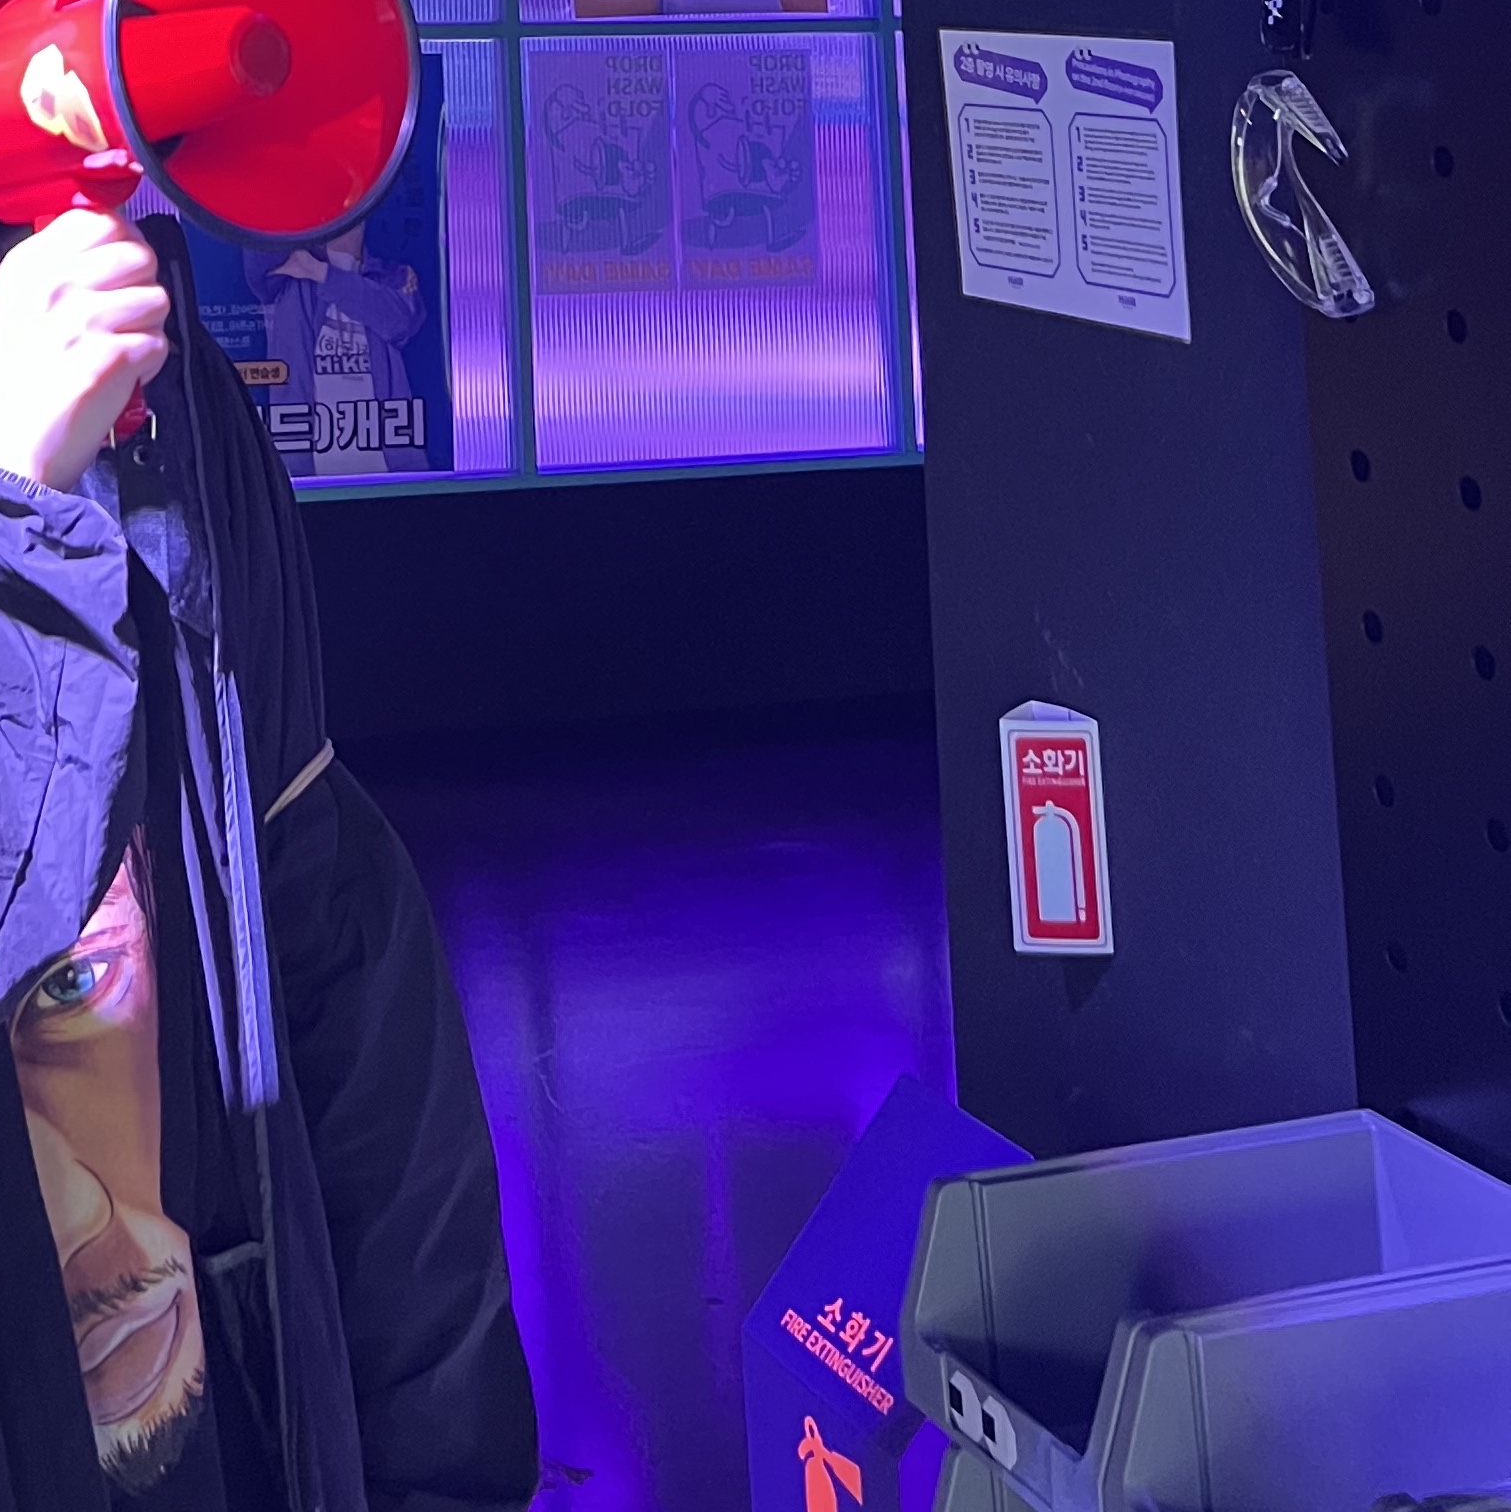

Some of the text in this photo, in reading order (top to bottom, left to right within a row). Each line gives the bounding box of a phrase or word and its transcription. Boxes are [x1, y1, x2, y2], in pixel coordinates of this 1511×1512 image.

[257, 397, 426, 453] 드)캐리
[1022, 748, 1085, 776] 소화기
[780, 1308, 895, 1416] FIRE EXTINGUISHER
[816, 1297, 894, 1373] 소화기
